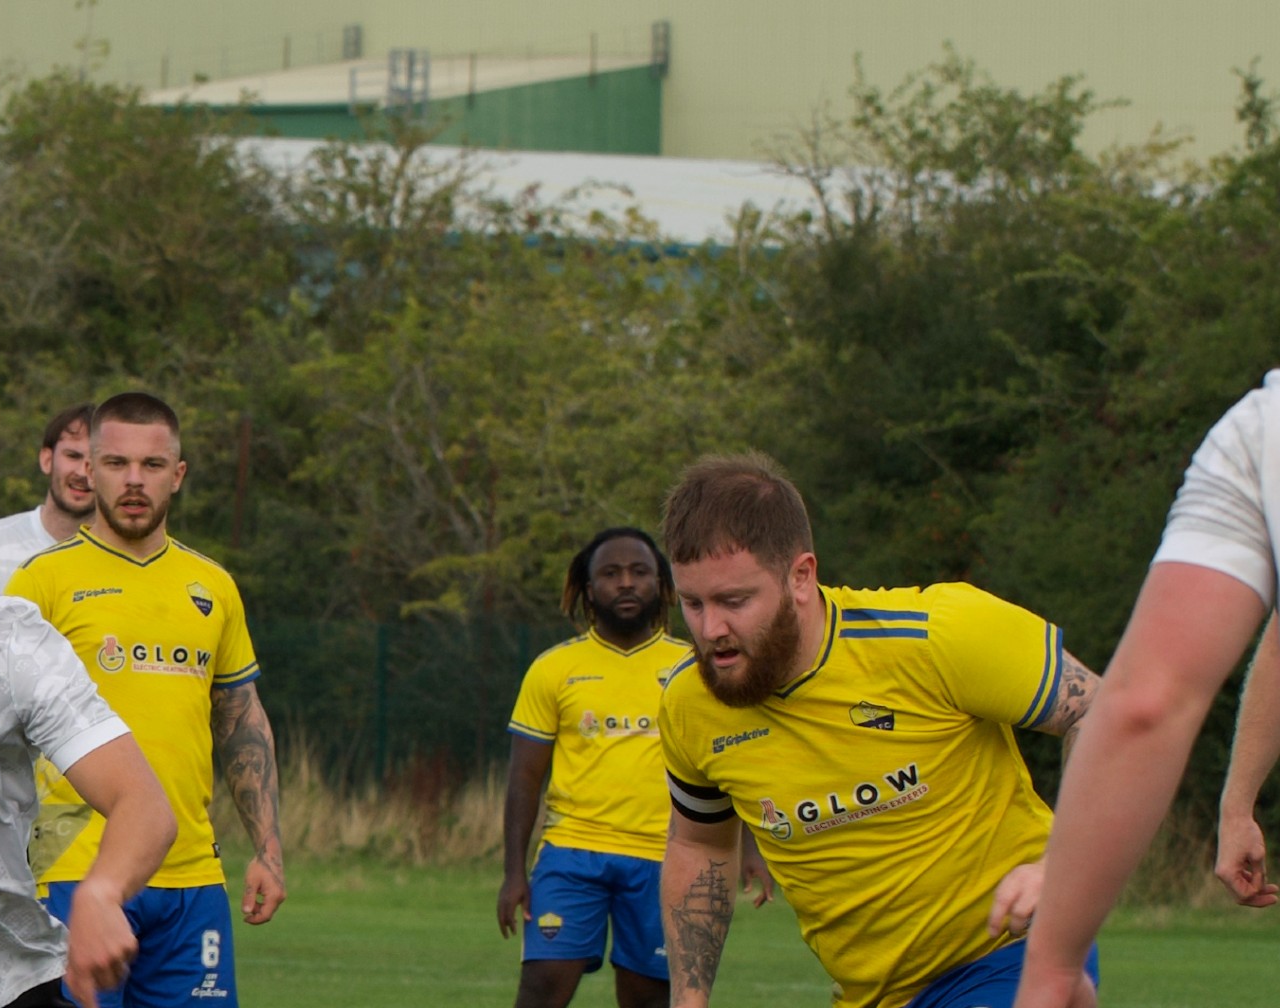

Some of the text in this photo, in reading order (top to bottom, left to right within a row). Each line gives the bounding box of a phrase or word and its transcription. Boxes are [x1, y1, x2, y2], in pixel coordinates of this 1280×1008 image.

[133, 645, 211, 666] GLOW
[606, 717, 650, 729] GLO
[797, 765, 917, 822] GLOW
[805, 785, 928, 834] ELECTRIC HEATING EXPERTS
[201, 930, 220, 968] 6
